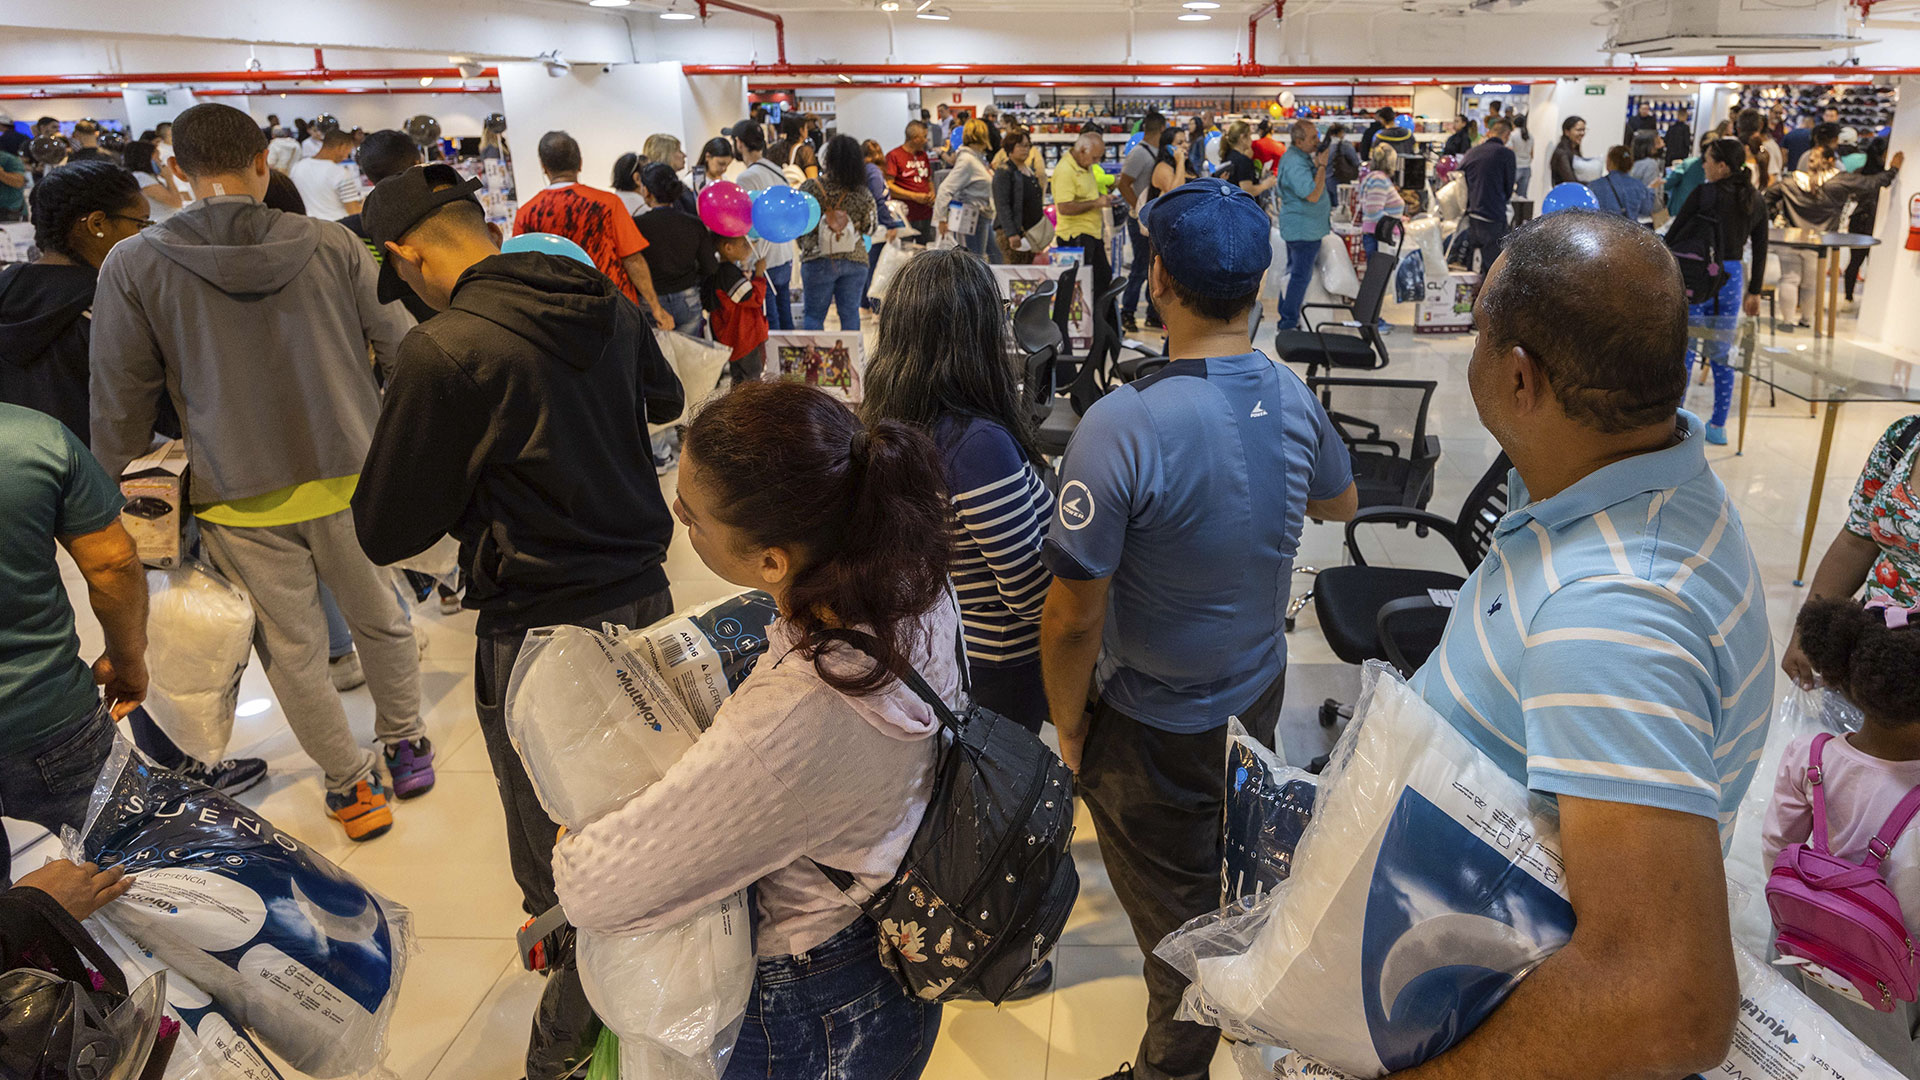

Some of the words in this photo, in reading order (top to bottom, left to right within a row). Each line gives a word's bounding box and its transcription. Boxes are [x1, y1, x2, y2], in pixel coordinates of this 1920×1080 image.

[1063, 506, 1084, 519] POWER
[680, 631, 699, 658] A0106
[125, 795, 298, 852] SUEÑO
